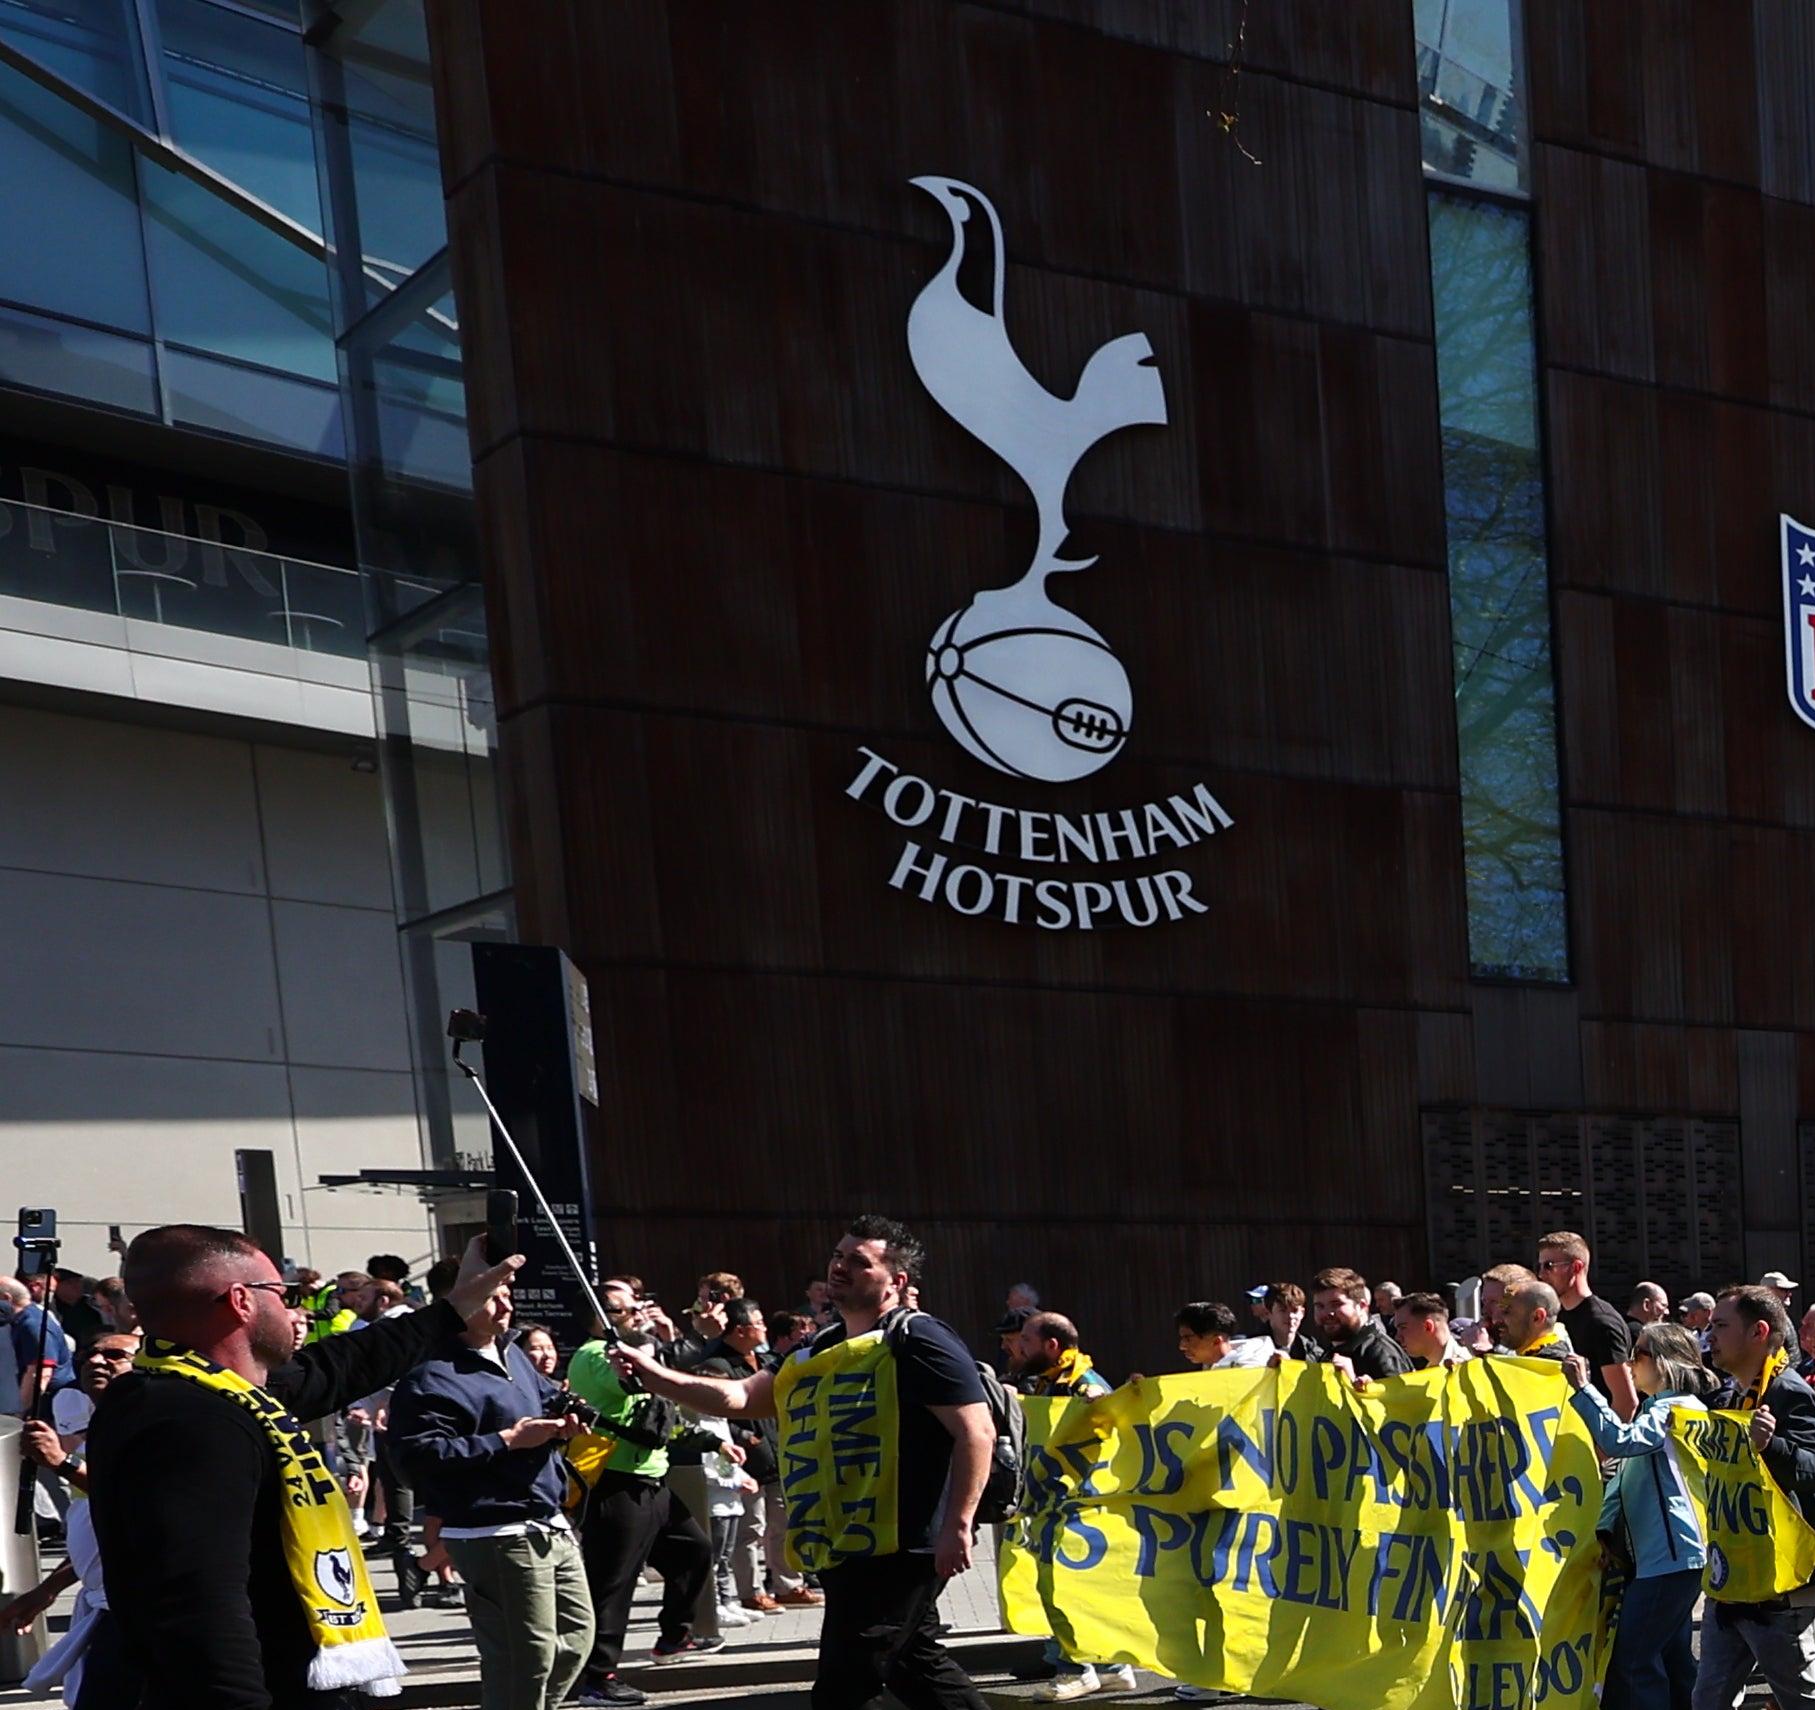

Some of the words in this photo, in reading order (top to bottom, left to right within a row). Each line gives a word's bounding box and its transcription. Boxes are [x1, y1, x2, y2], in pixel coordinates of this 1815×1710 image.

[0, 465, 280, 597] PUR
[844, 746, 1235, 864] TOTTENHAM
[888, 841, 1208, 930] HOTSPUR
[784, 1375, 835, 1568] CHANG
[828, 1372, 882, 1486] TIME
[1131, 1421, 1195, 1495] IS
[1216, 1407, 1299, 1496] NO
[840, 1496, 878, 1557] FO
[1132, 1504, 1361, 1612] PURELY
